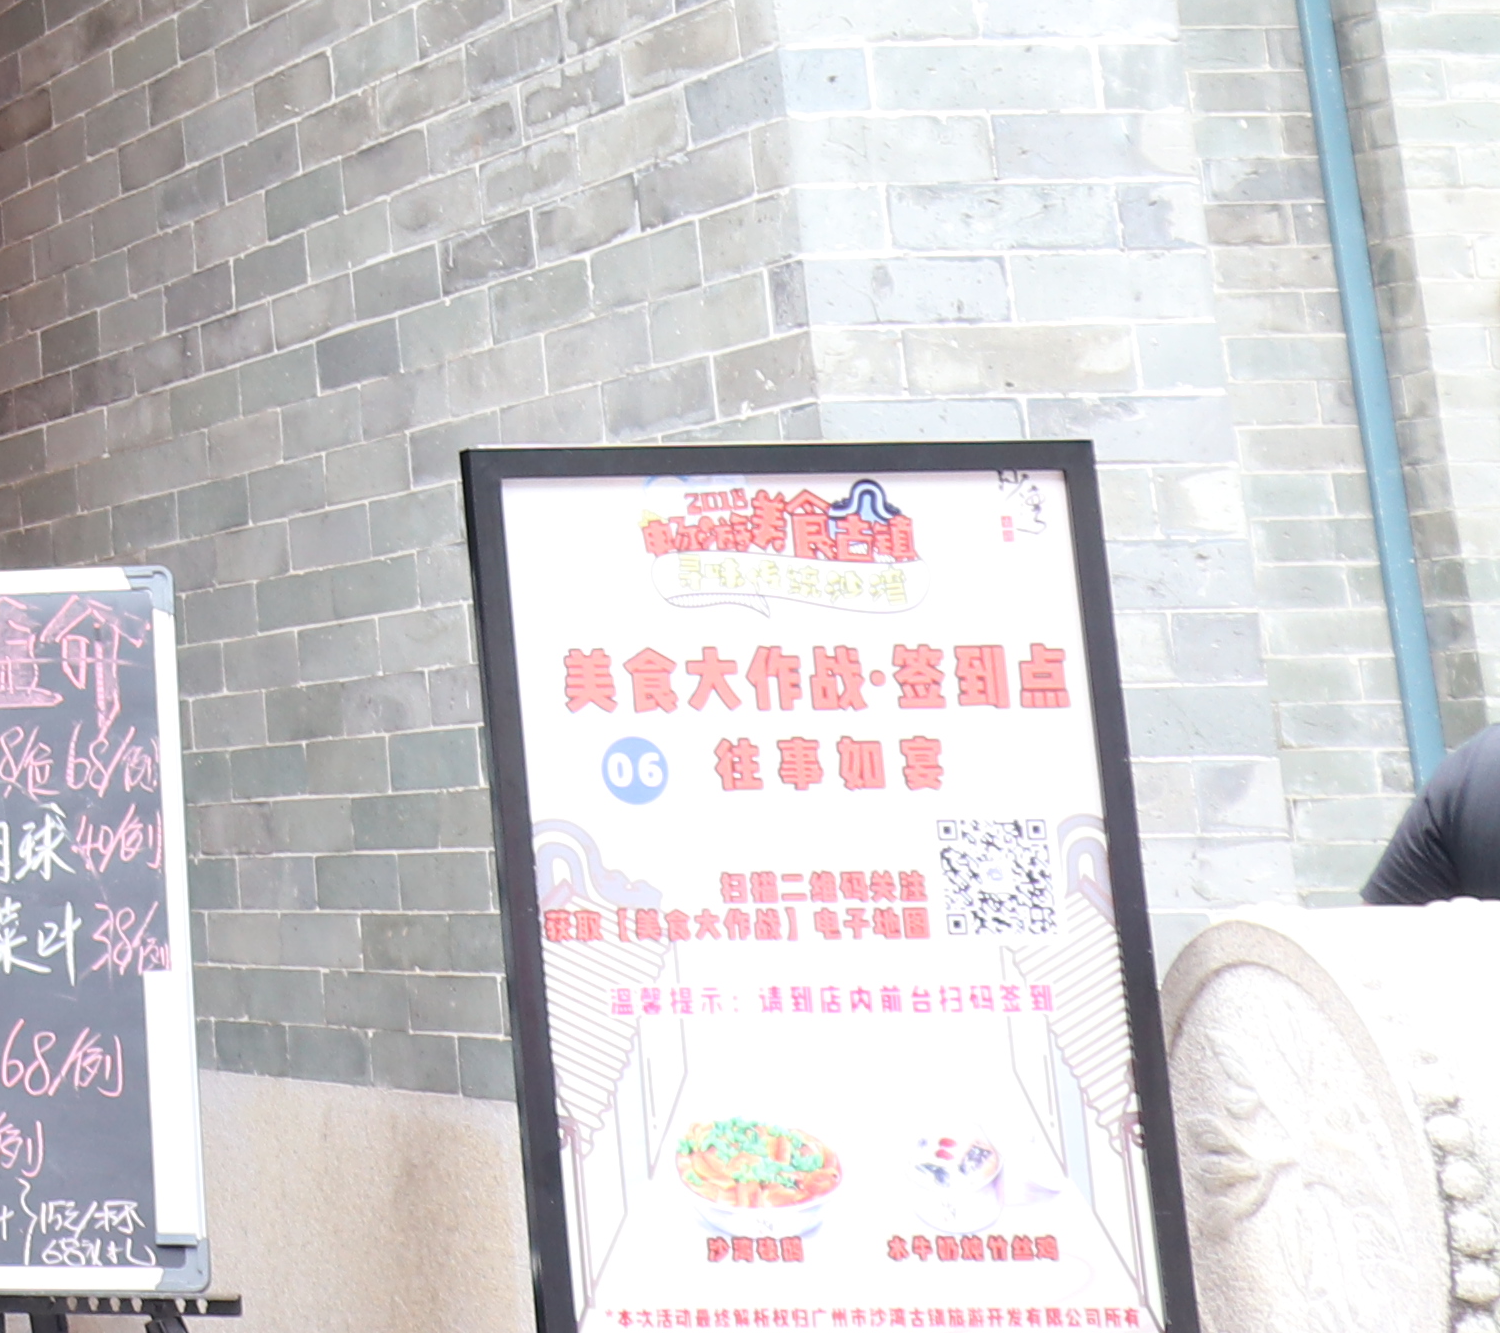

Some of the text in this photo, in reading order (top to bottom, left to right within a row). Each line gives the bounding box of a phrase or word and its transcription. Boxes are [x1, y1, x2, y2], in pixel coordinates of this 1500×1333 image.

[684, 487, 751, 516] 2018
[564, 643, 1071, 714] 美食大作战·签到点
[606, 736, 946, 792] 06 往事如宴
[720, 870, 929, 905] 扫描二维码关注
[0, 1018, 125, 1099] 68/例
